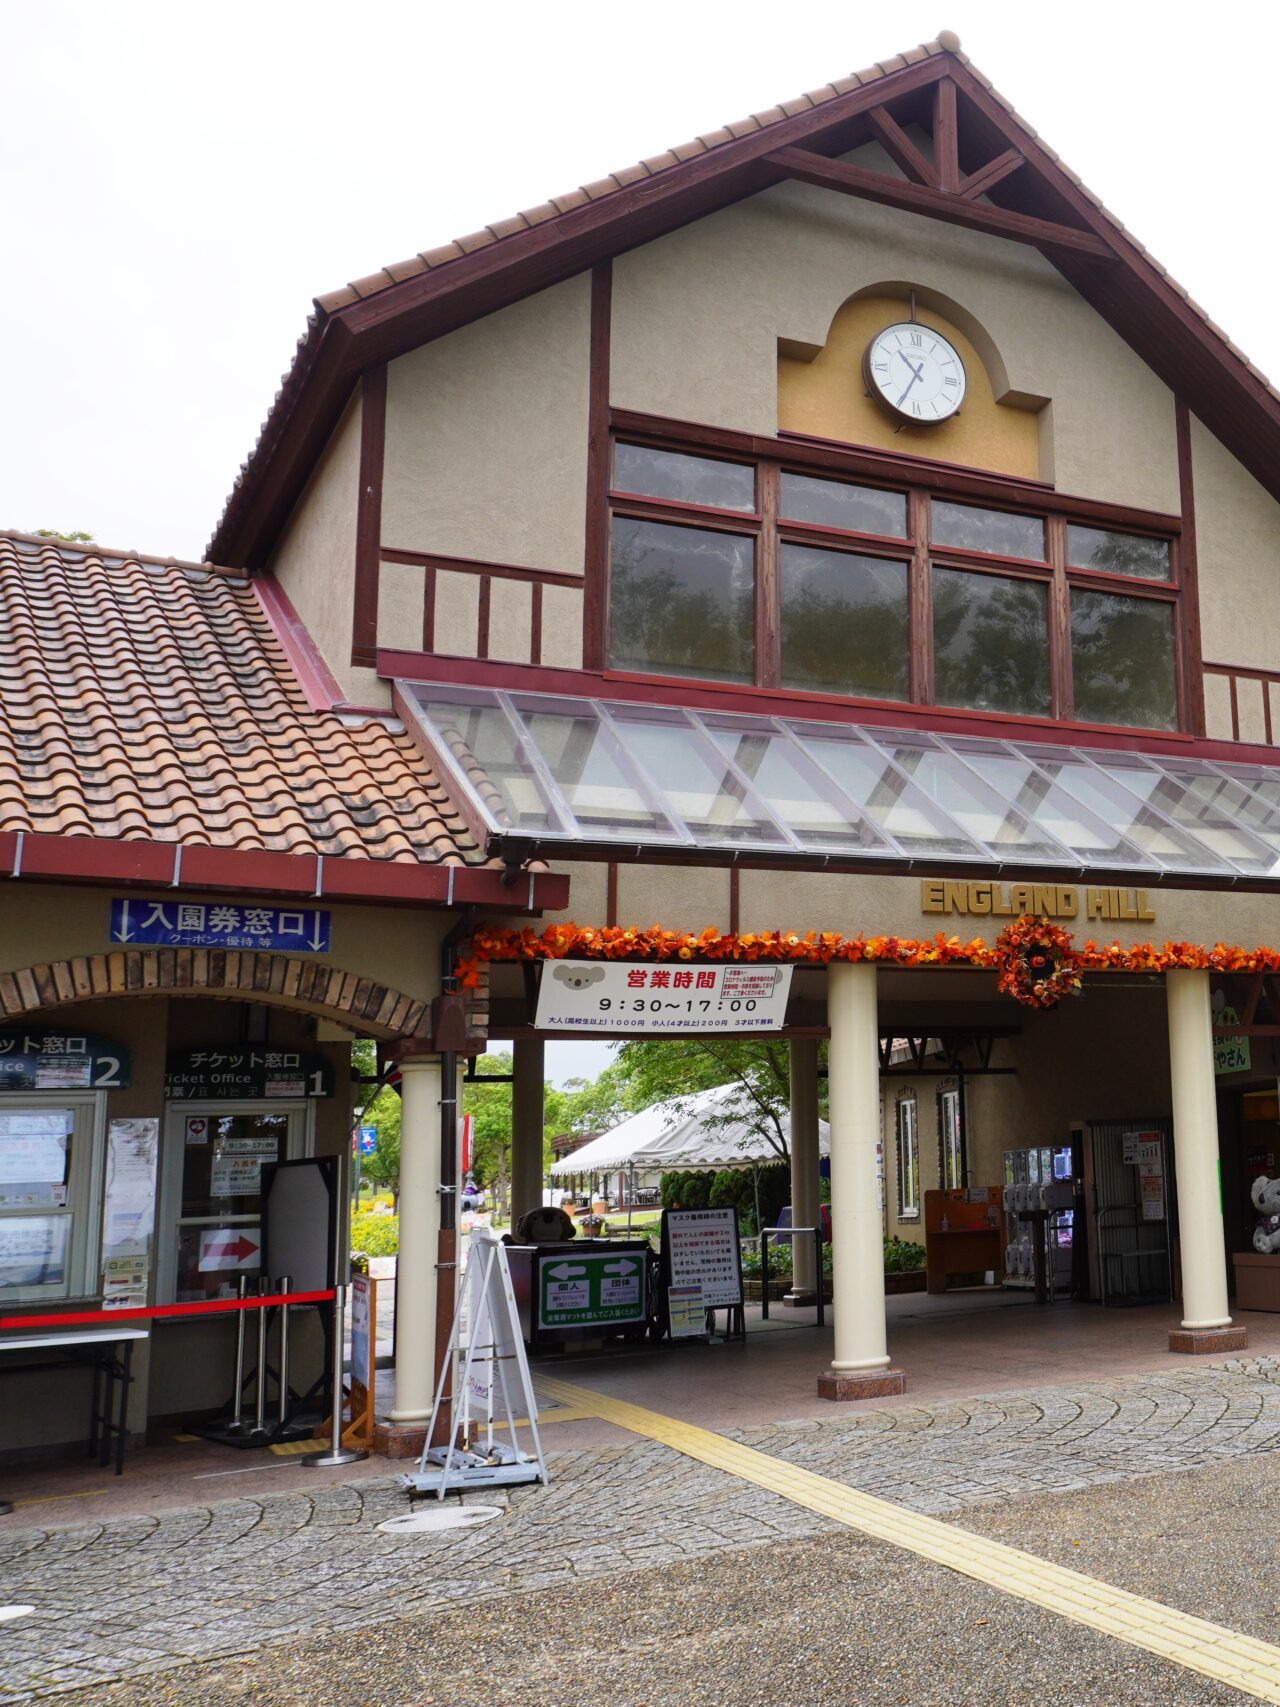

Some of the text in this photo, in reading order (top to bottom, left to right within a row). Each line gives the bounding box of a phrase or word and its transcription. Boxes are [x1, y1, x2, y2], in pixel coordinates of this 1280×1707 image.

[922, 880, 1156, 920] ENGLAND HILL
[140, 903, 305, 935] 入園券窓口
[627, 970, 716, 989] 営業時間
[599, 999, 757, 1012] 9:30~17:00
[190, 1052, 300, 1068] チケット窓口
[94, 1057, 120, 1086] 2
[210, 1073, 251, 1084] Office
[309, 1070, 327, 1096] 1
[558, 1282, 579, 1291] 個人
[611, 1278, 631, 1287] 団体
